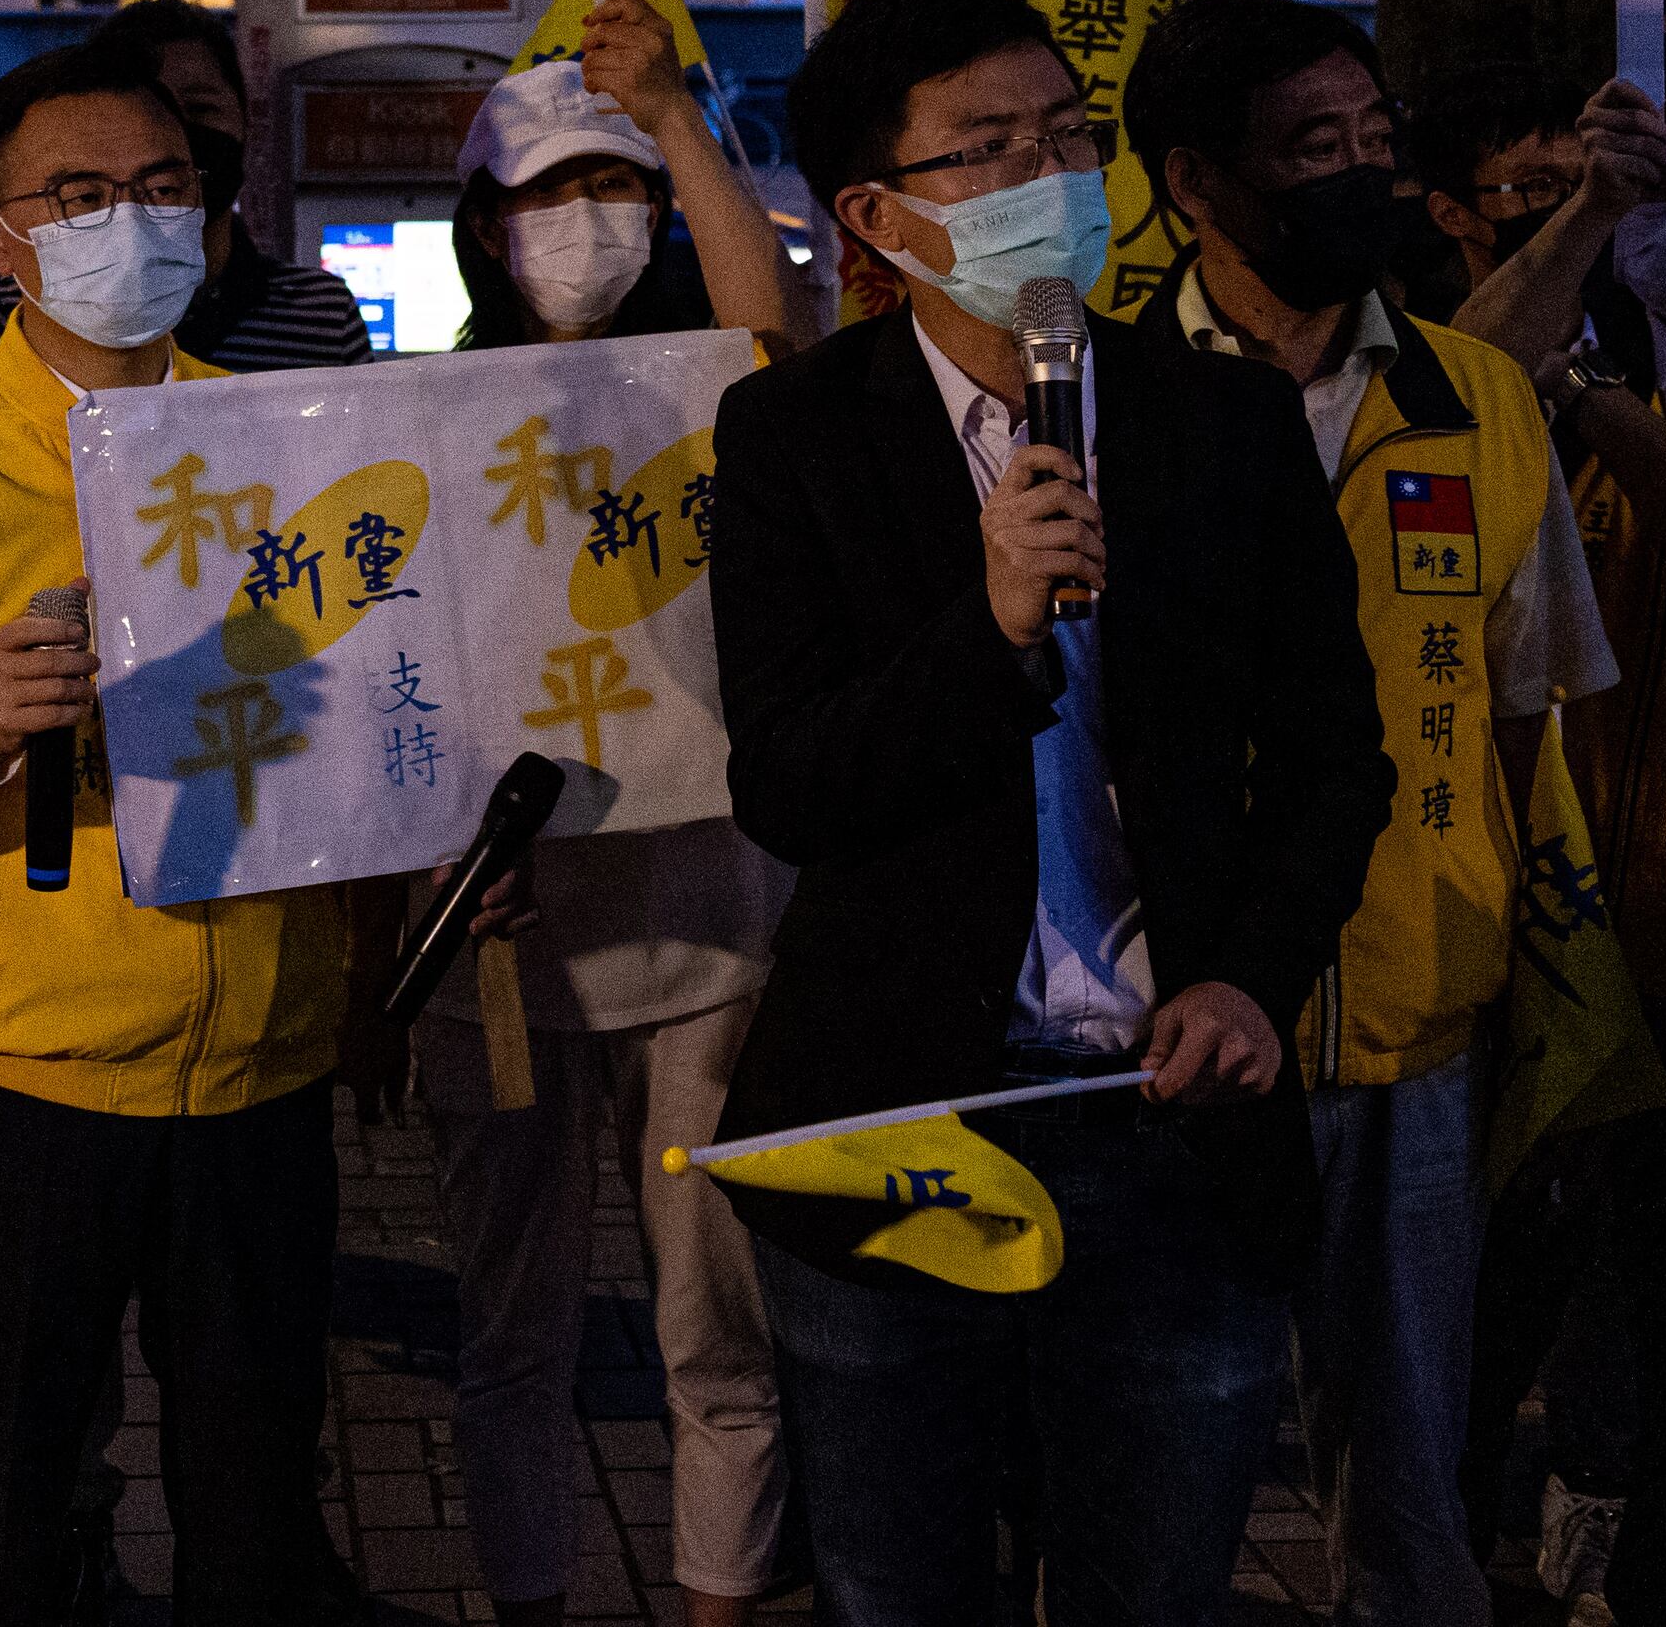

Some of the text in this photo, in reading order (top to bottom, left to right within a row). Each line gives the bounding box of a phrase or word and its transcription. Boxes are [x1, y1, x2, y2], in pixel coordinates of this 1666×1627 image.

[136, 451, 309, 829] 和平
[245, 512, 421, 621] 新黨
[484, 414, 653, 775] 和平
[383, 651, 447, 789] 支持
[1416, 621, 1465, 842] 蔡明璋
